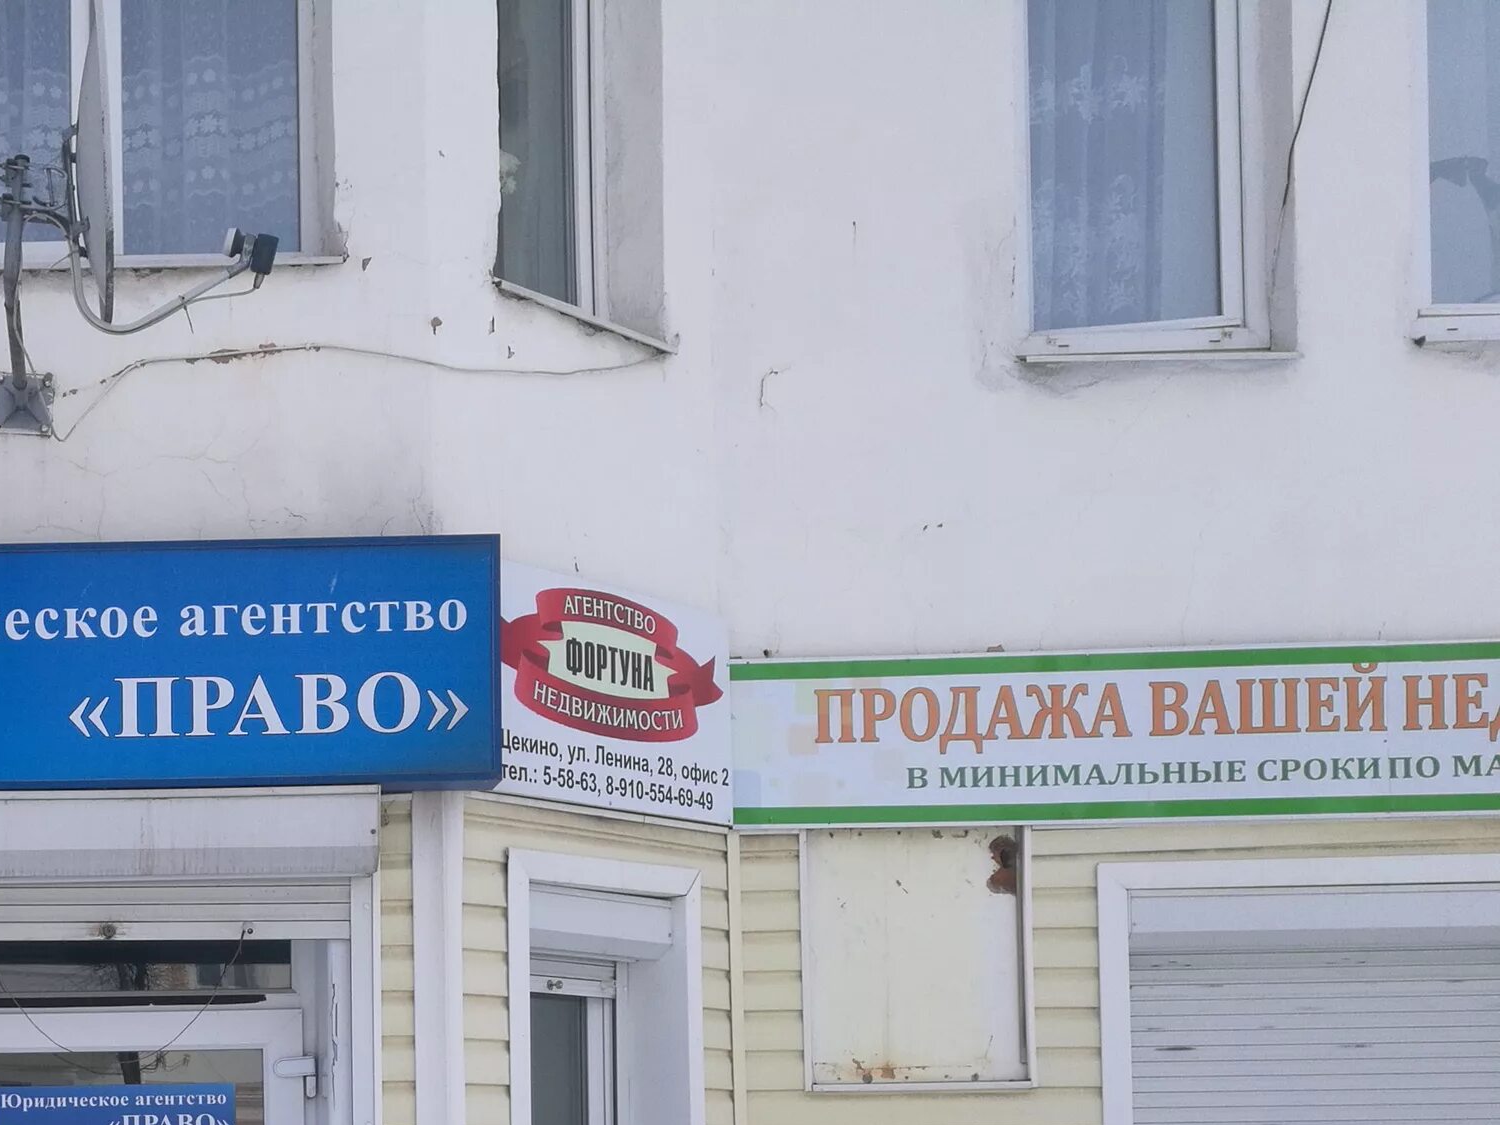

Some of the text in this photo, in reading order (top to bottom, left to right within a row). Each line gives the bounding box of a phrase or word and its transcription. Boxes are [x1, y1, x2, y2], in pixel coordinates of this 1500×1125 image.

[179, 598, 468, 637] агентство
[564, 595, 656, 634] АГЕНТСТВО
[565, 637, 655, 692] ФОРТУНА
[68, 671, 470, 739] «ПРАВО»
[533, 681, 684, 730] НЕДВИЖИМОСТИ
[814, 682, 1132, 755] ПРОДАЖА
[1149, 662, 1388, 737] ВАШЕЙ
[567, 745, 590, 766] ул.
[595, 745, 653, 777] Ленина,
[657, 756, 677, 780] 28,
[682, 763, 718, 785] офис
[721, 768, 730, 786] 2
[906, 766, 928, 789] В
[939, 760, 1246, 789] МИНИМАЛЬНЫЕ
[1257, 757, 1381, 782] СРОКИ
[1388, 755, 1440, 779] ПО
[543, 765, 601, 797] 5-58-63,
[606, 775, 714, 811] 8-910-554-69-49
[1, 1093, 227, 1112] Юридическое агентство
